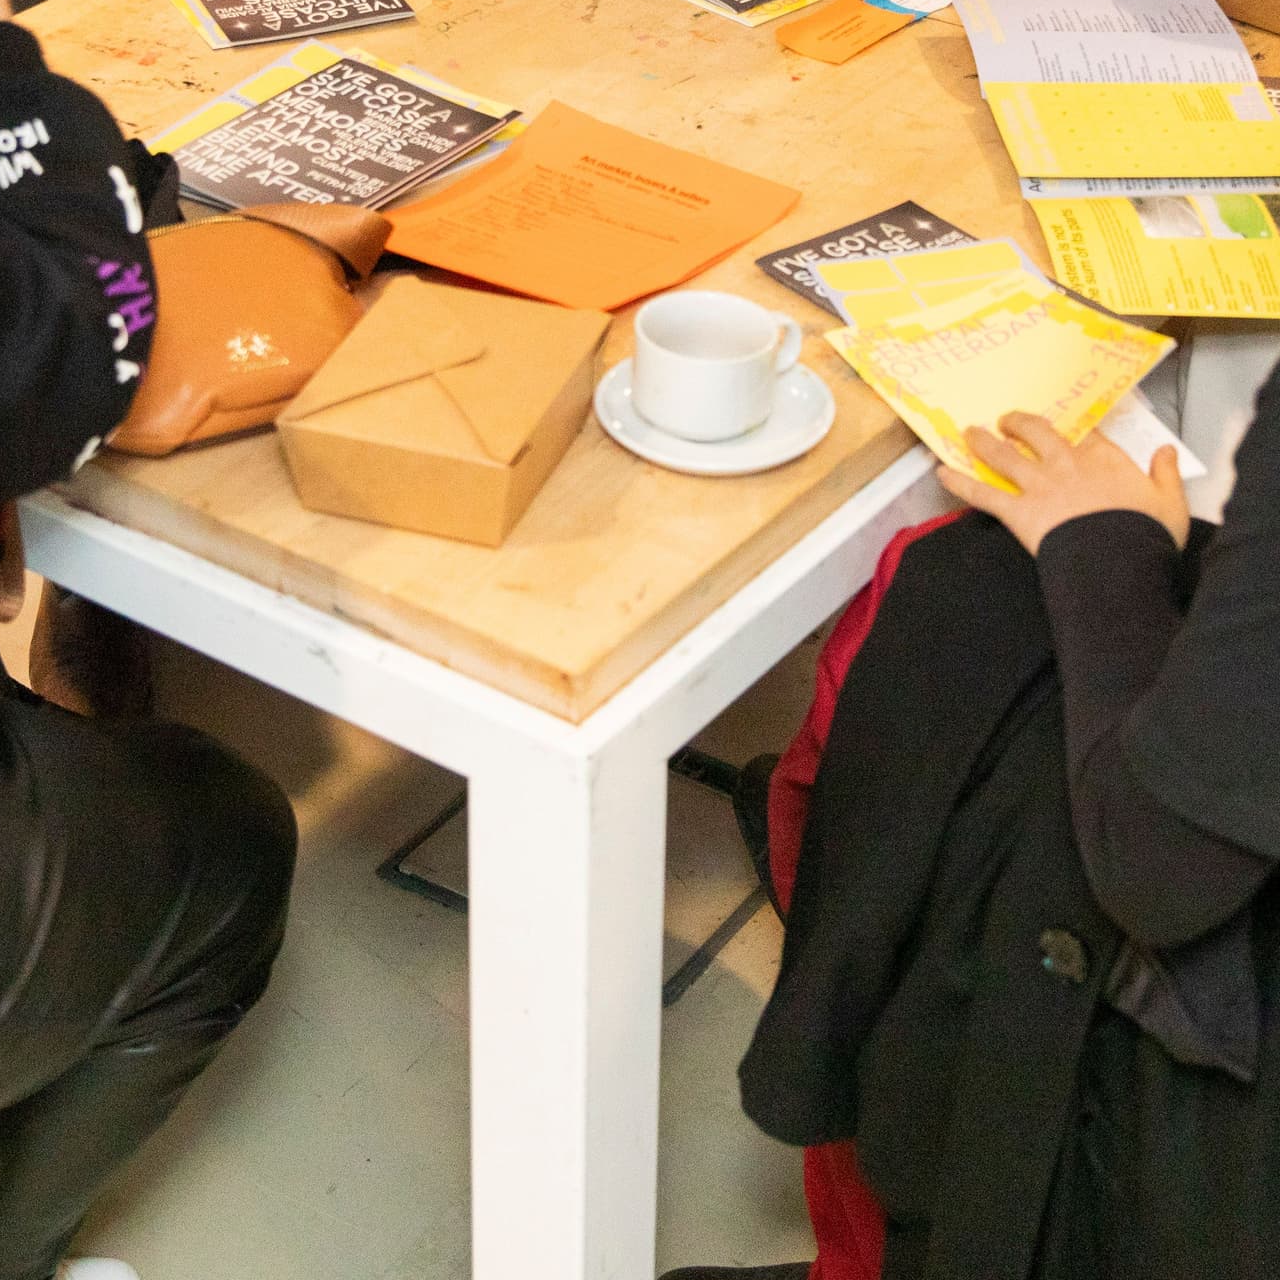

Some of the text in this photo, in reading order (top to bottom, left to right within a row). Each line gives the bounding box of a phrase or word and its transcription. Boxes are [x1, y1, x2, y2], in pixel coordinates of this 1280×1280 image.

[263, 20, 282, 31] A
[294, 8, 349, 28] GOT
[295, 83, 336, 100] OF
[312, 73, 437, 130] SUITCASE
[326, 64, 453, 122] I'VE GOT A
[222, 121, 292, 151] LEFT
[262, 100, 332, 133] THAT
[275, 91, 408, 152] MEMORIES
[205, 129, 300, 176] BEHIND
[251, 117, 364, 166] ALMOST
[174, 149, 228, 183] TIME
[191, 140, 335, 205] TIME AFTER
[772, 222, 906, 275] I'VE GOT A
